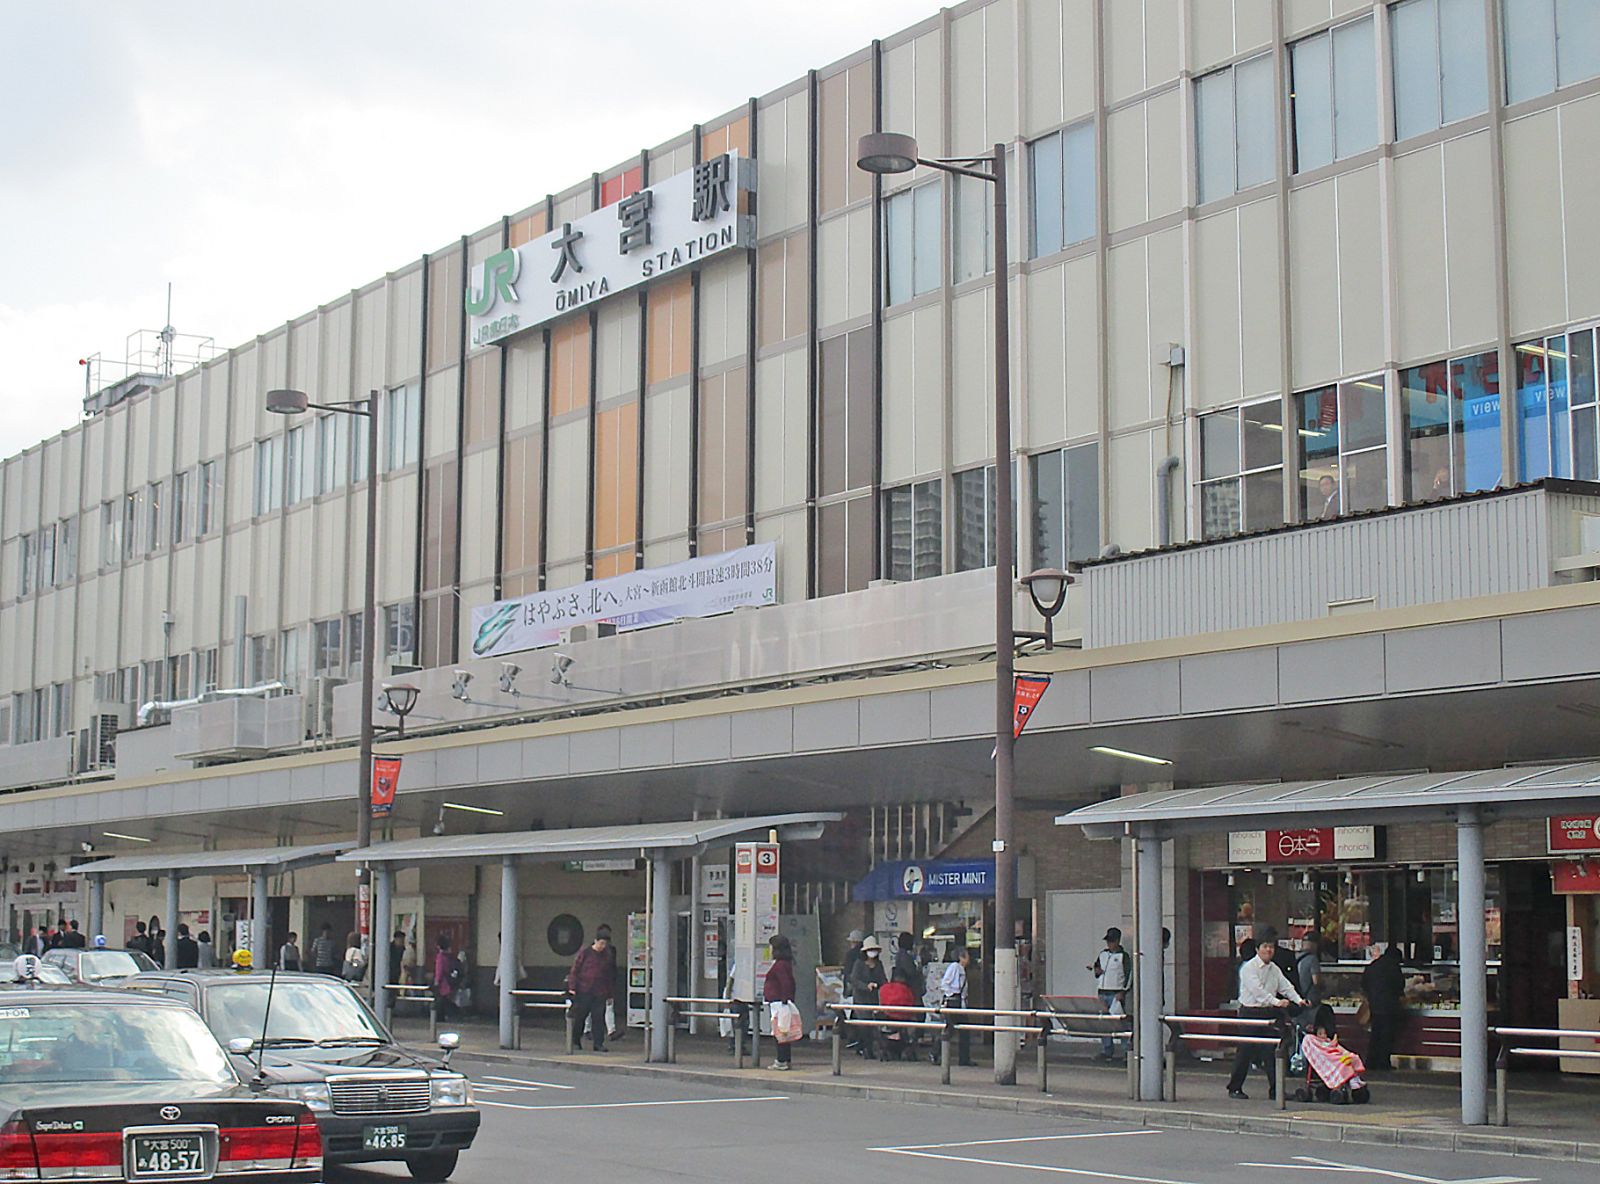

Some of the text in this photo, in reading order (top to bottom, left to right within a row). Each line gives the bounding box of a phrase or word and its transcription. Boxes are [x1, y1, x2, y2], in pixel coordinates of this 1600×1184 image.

[642, 225, 733, 277] STATION
[465, 248, 520, 316] JR
[763, 853, 771, 864] 3
[929, 872, 987, 886] MISTER MINIT
[150, 1139, 188, 1150] 大宮 500
[372, 1133, 406, 1149] 46-85
[149, 1150, 201, 1171] 48-57
